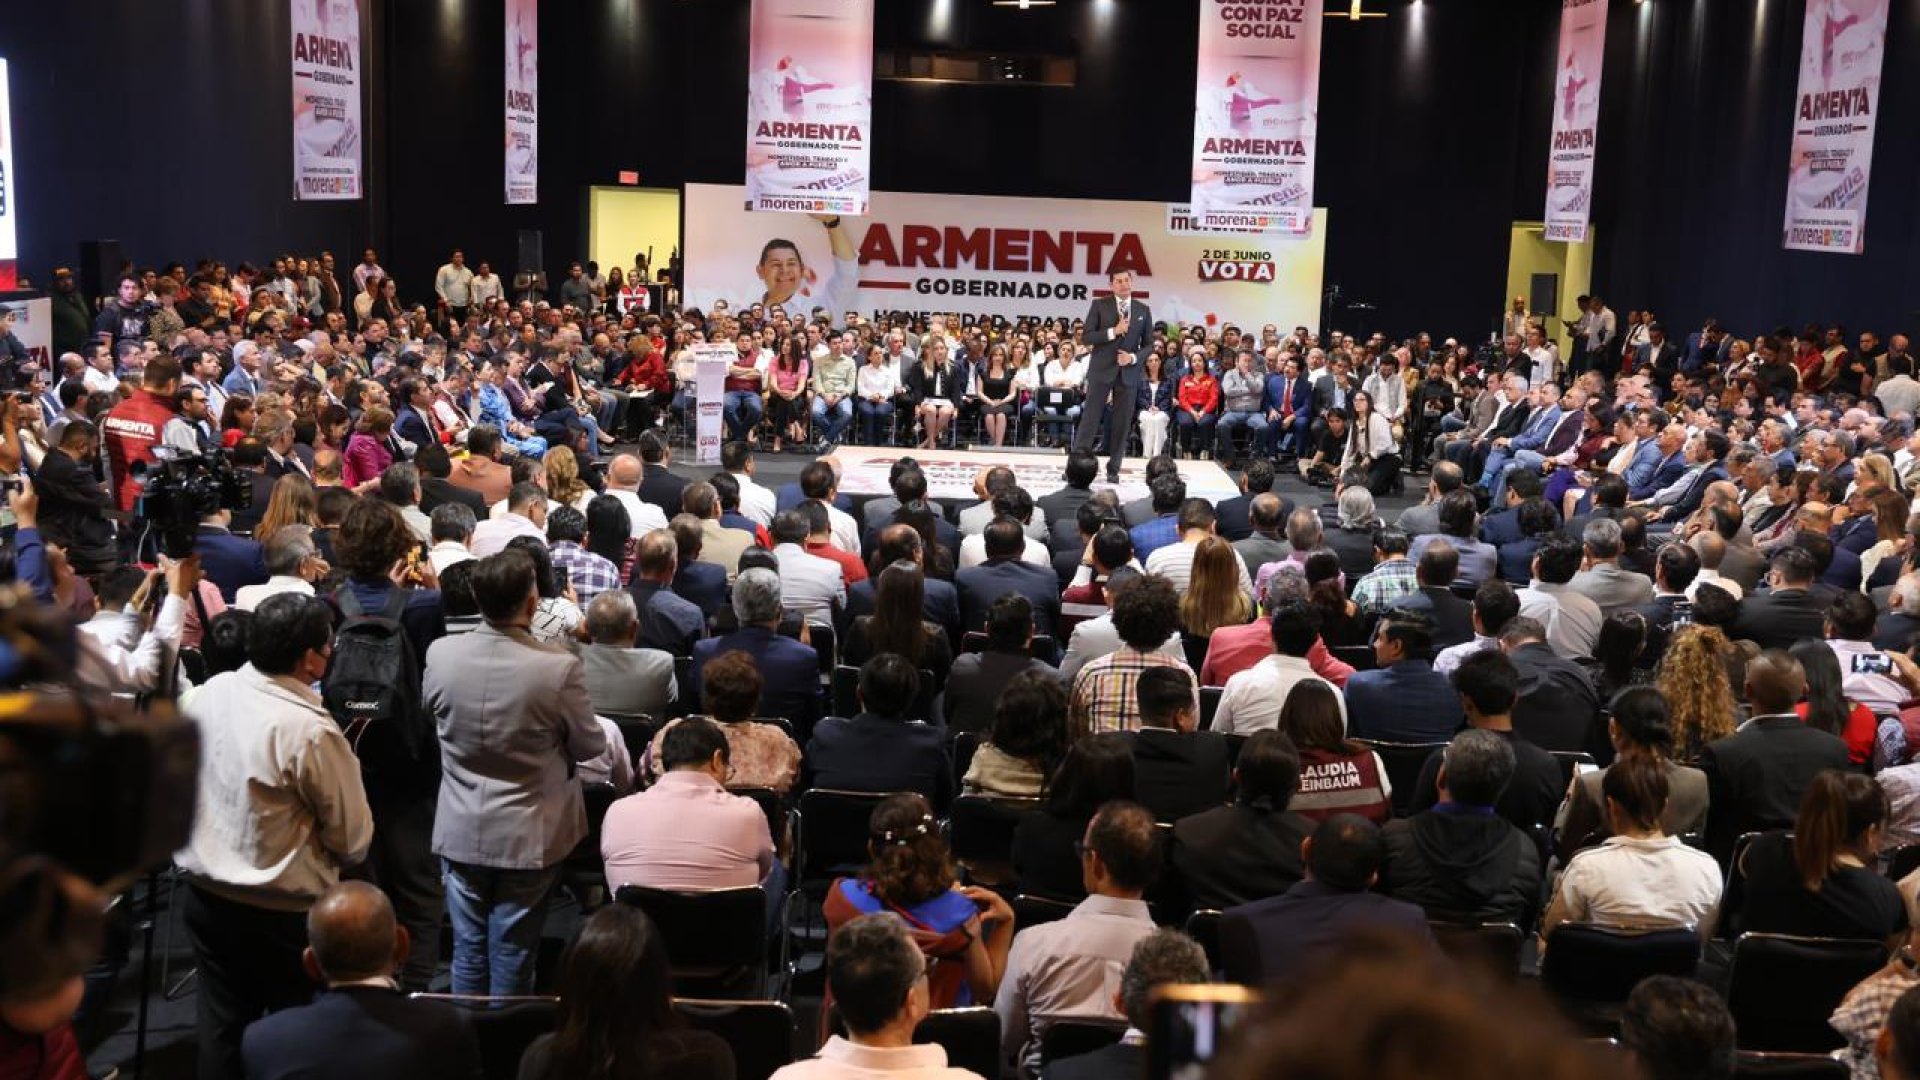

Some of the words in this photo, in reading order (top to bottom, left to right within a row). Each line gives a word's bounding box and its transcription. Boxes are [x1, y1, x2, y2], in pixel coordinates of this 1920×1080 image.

[1221, 6, 1261, 21] CON
[1265, 7, 1302, 23] PAZ
[1226, 23, 1295, 39] SOCIAL
[756, 121, 861, 141] ARMENTA
[777, 141, 840, 150] GOBERNADOR
[1203, 138, 1305, 156] ARMENTA
[1223, 157, 1285, 166] GOBERNADOR
[760, 198, 812, 210] morena
[1205, 215, 1257, 226] morena
[858, 223, 1152, 276] ARMENTA
[1202, 249, 1210, 259] 2
[1213, 250, 1230, 259] DE
[1233, 250, 1271, 260] JUNIO
[1201, 261, 1272, 279] VOTA
[916, 278, 1088, 300] GOBERNADOR
[1300, 762, 1358, 779] AUDIA
[1299, 773, 1361, 791] EINBAUM
